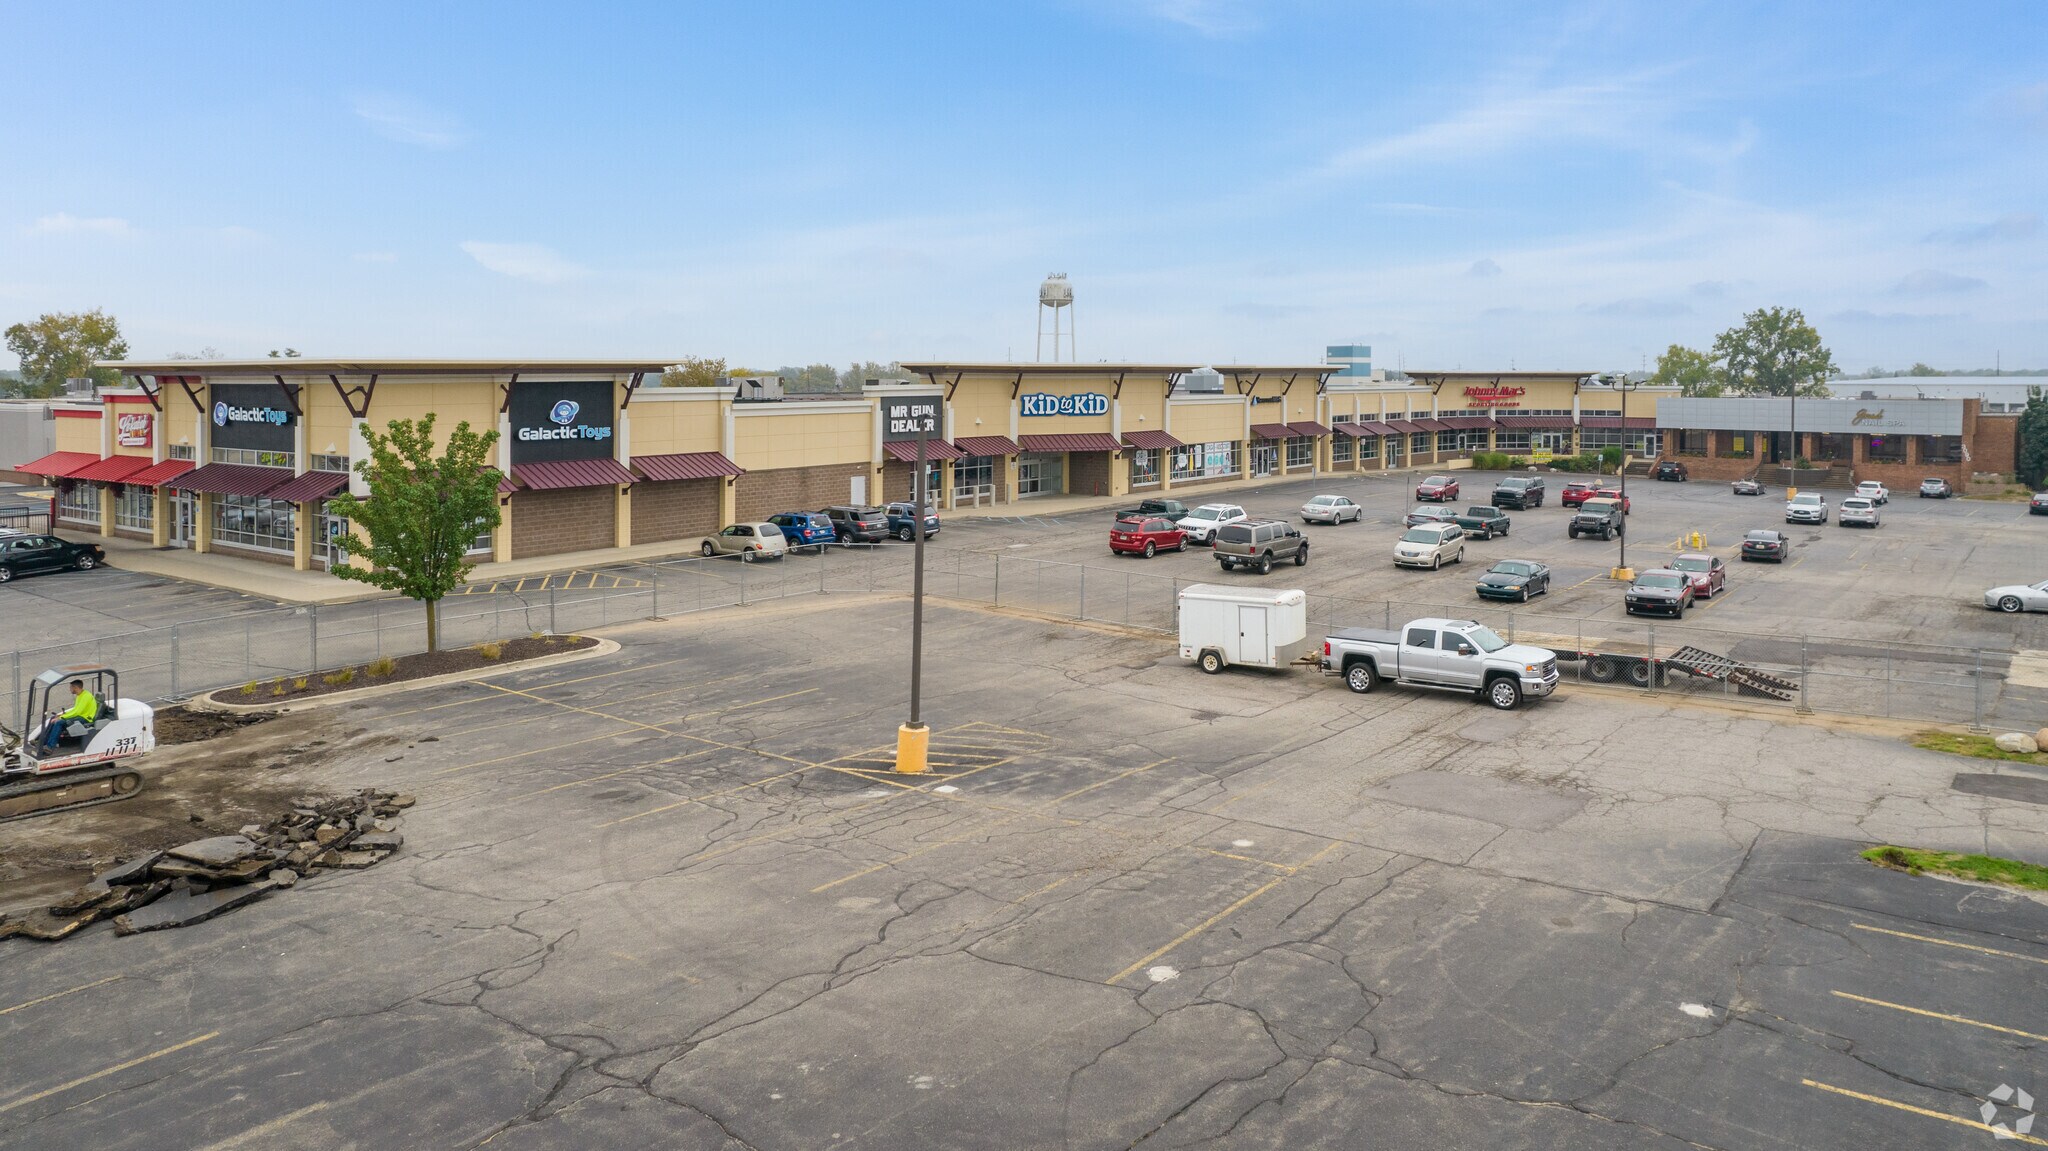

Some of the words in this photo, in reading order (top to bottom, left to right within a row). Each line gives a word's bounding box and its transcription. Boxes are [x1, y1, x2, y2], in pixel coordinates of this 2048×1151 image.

[1464, 386, 1499, 397] Johnny
[1060, 397, 1073, 409] to
[890, 405, 908, 418] MR
[911, 404, 934, 417] GUN
[115, 736, 137, 747] 337
